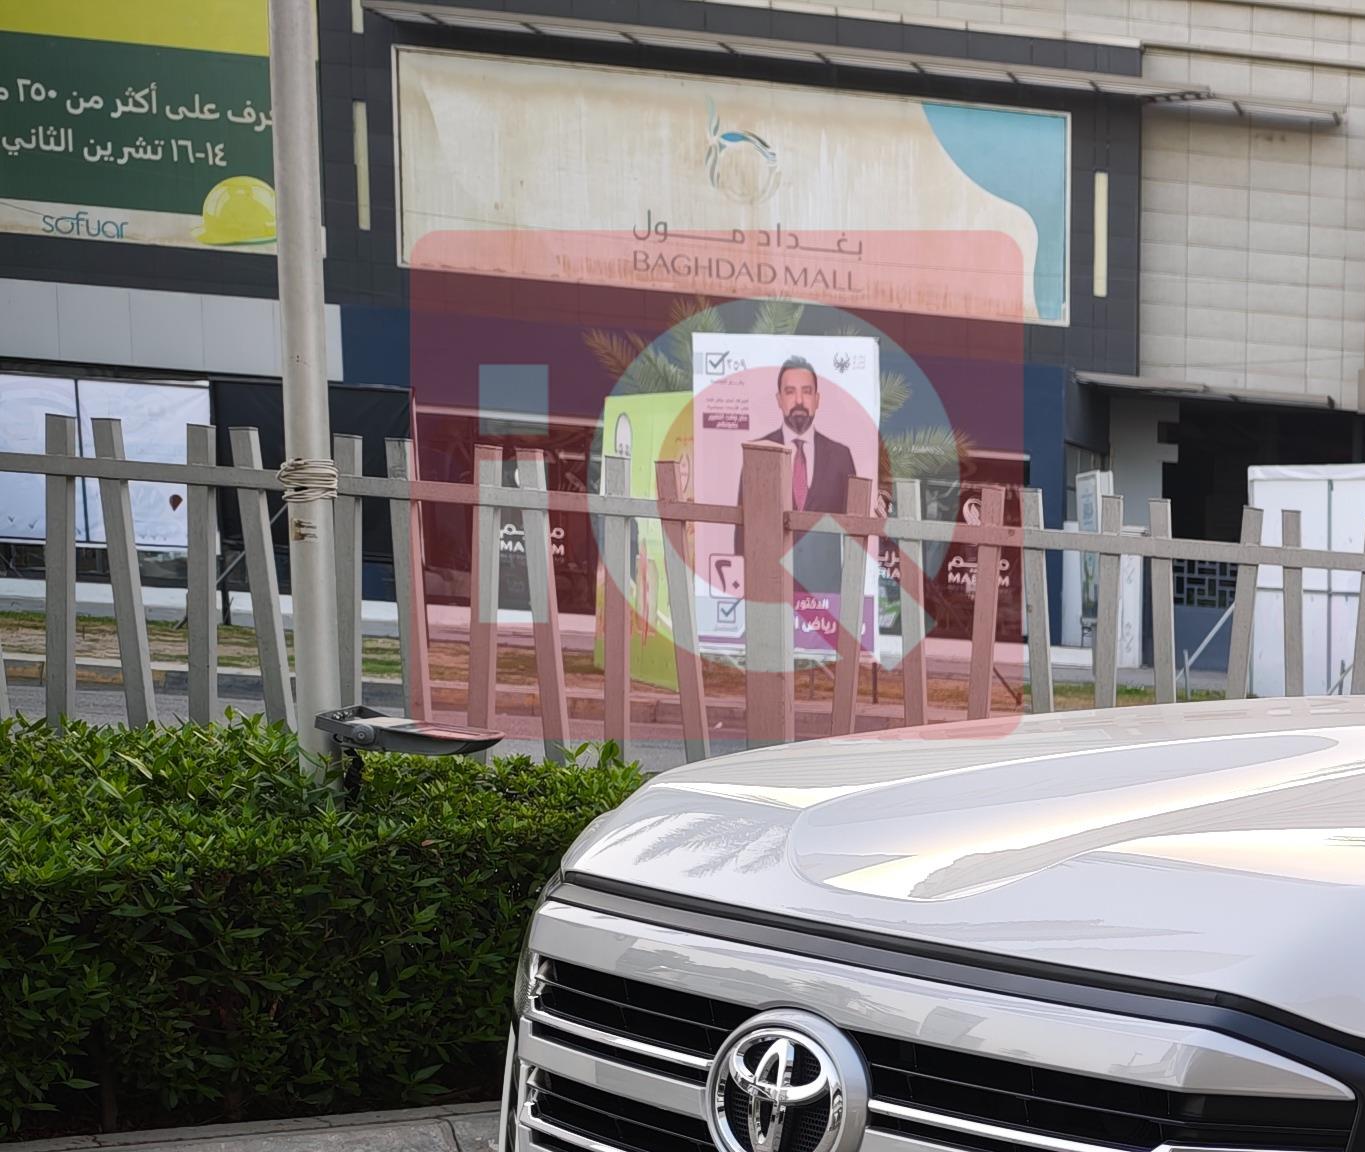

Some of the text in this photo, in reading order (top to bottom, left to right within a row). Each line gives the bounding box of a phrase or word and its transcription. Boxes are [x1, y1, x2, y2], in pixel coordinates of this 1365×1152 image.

[17, 78, 57, 102] ٢٥٠
[66, 90, 104, 115] من
[110, 82, 157, 118] أكثر
[165, 94, 220, 121] على
[1, 126, 73, 156] الثاني
[83, 136, 164, 165] تشرين
[633, 250, 863, 293] BAGHDAD MALL
